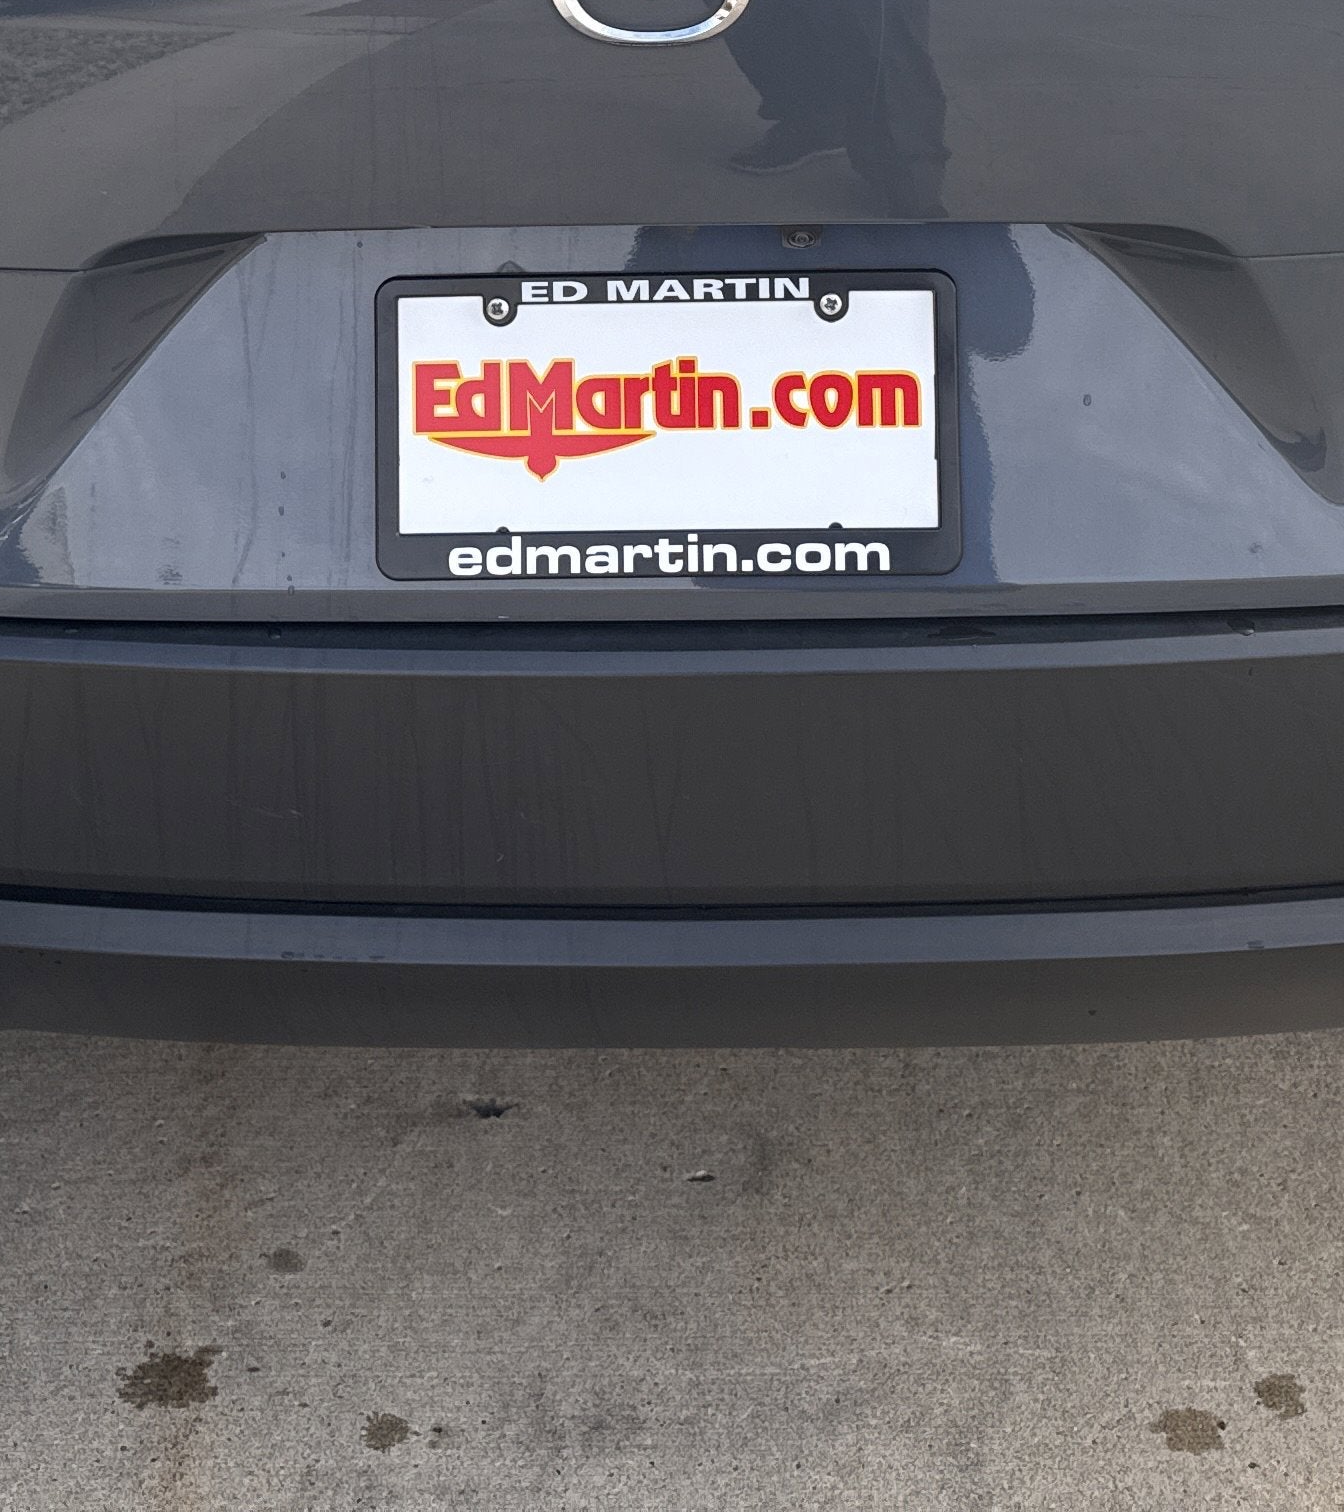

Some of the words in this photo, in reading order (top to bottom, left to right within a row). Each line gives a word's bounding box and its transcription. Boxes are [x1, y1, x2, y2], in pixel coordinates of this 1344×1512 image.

[521, 280, 588, 303] ED
[606, 277, 809, 301] MARTIN
[412, 356, 922, 435] EdMartin.com
[448, 534, 891, 577] edmartin.com
